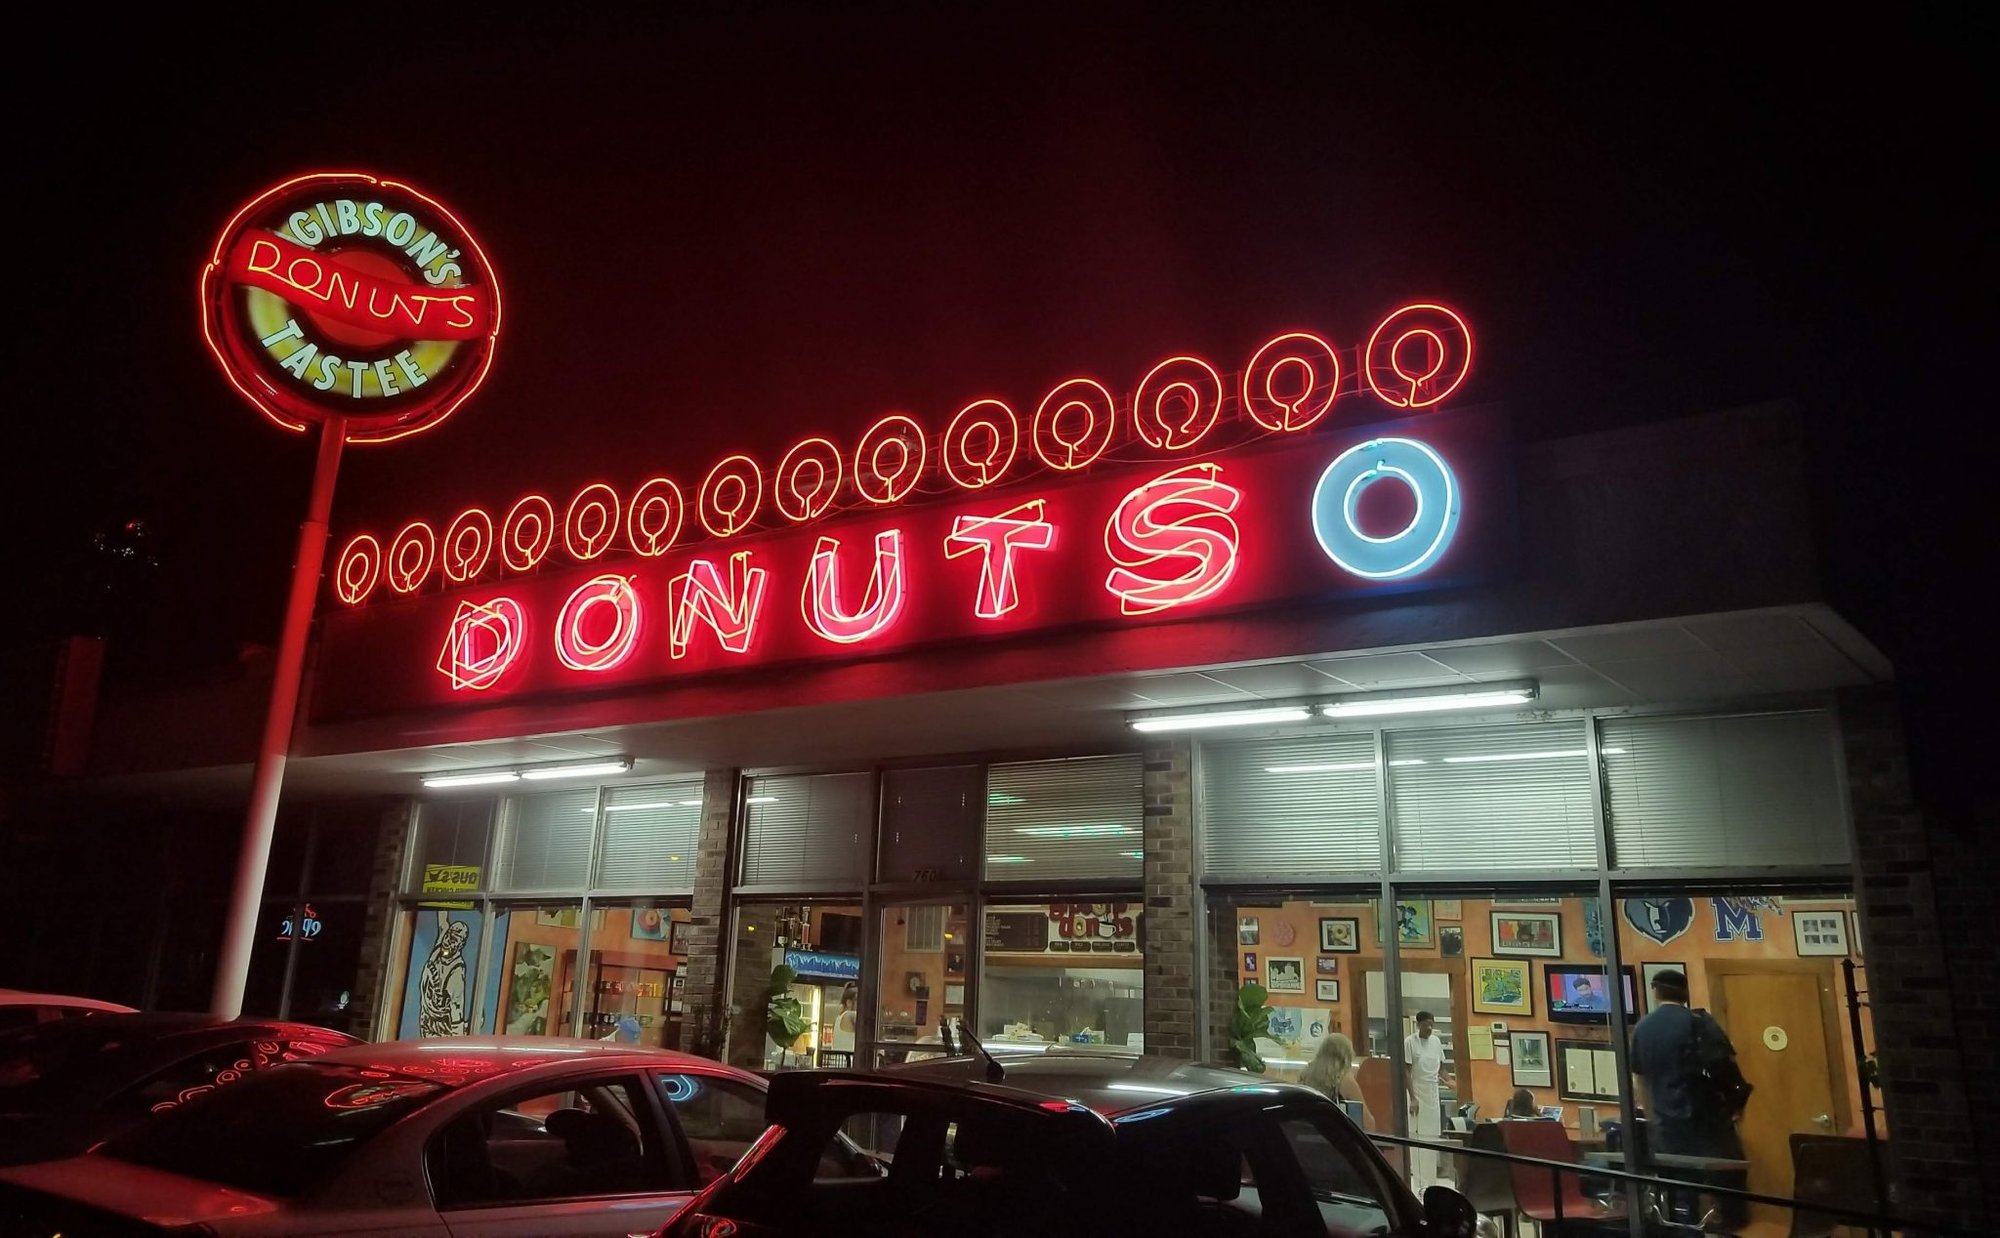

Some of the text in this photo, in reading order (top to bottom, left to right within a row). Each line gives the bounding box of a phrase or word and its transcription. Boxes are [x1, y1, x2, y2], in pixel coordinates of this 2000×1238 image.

[248, 241, 475, 328] DONUTS
[287, 200, 462, 285] GIBSON'S
[261, 318, 428, 399] TASTEE
[436, 463, 1245, 690] DONUTS
